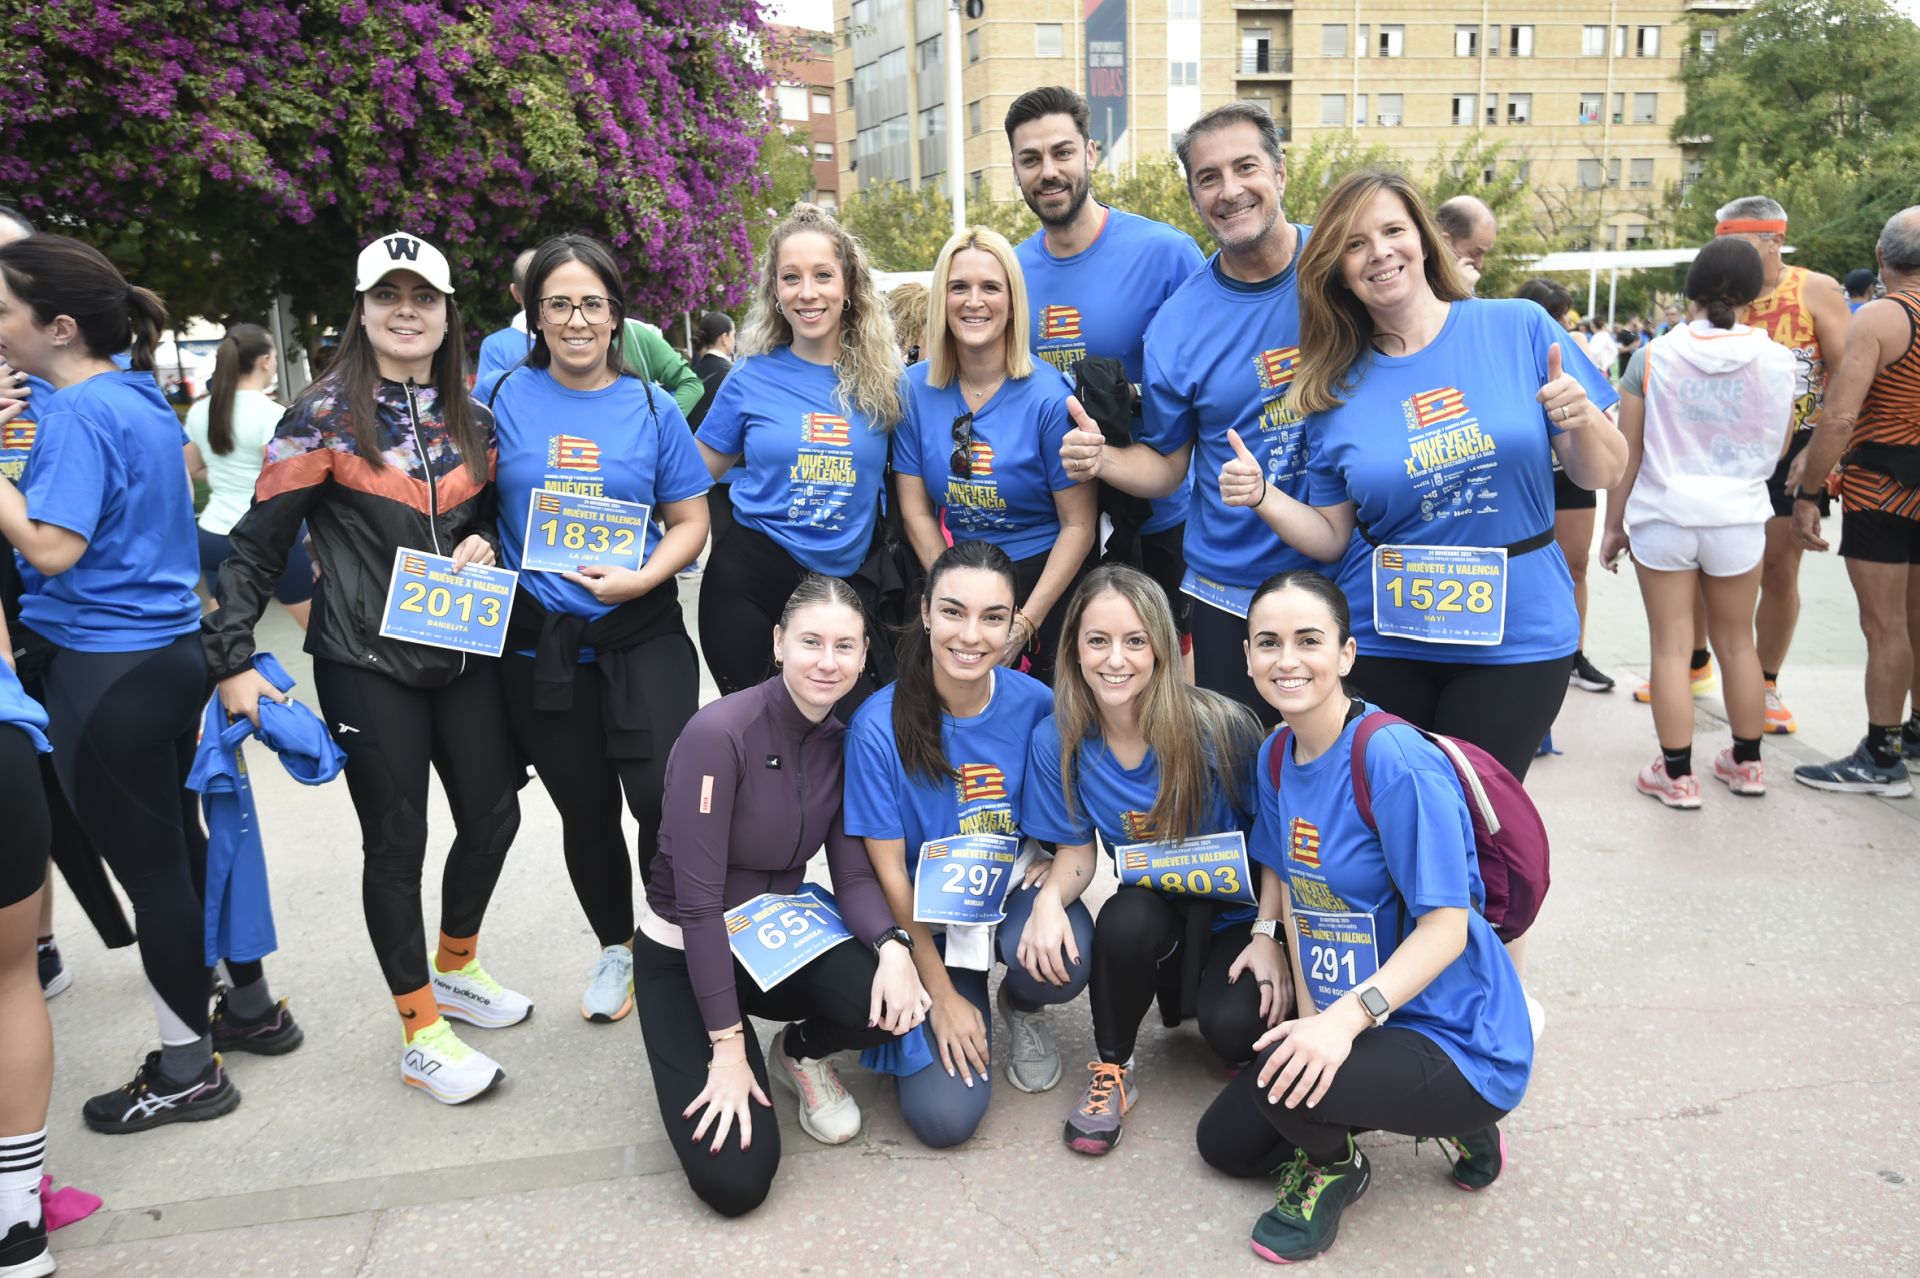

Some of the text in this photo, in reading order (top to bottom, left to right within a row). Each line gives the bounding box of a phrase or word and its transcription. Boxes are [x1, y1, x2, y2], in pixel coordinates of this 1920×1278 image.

[383, 237, 421, 262] W
[1259, 414, 1269, 429] X
[1409, 423, 1481, 458] MUÉVETE
[798, 453, 853, 470] MUÉVETE
[1404, 433, 1497, 475] X VALENCIA
[790, 466, 857, 484] X VALENCIA
[544, 479, 604, 498] MUÉVETE
[947, 480, 999, 499] MUÉVETE
[952, 491, 1007, 509] VALENCIA
[562, 506, 598, 520] MUÉVETE
[598, 512, 605, 521] X
[606, 513, 642, 526] VALENCIA
[540, 518, 636, 556] 1832
[1406, 560, 1500, 576] MUÉVETE X VALENCIA
[428, 569, 464, 586] MUÉVETE
[465, 579, 474, 588] X
[473, 580, 510, 596] VALENCIA
[399, 581, 502, 628] 2013
[1386, 576, 1494, 614] 1528
[427, 619, 470, 633] DANIELITA
[1424, 614, 1445, 622] MAYI
[951, 847, 988, 860] MUÉVETE
[1151, 855, 1190, 869] MUÉVETE
[1190, 854, 1198, 864] X
[1199, 849, 1240, 863] VALENCIA
[941, 862, 1003, 896] 297
[757, 908, 828, 950] 651
[1341, 931, 1372, 944] VALENCIA
[1310, 945, 1357, 986] 291
[434, 978, 491, 1005] new balance
